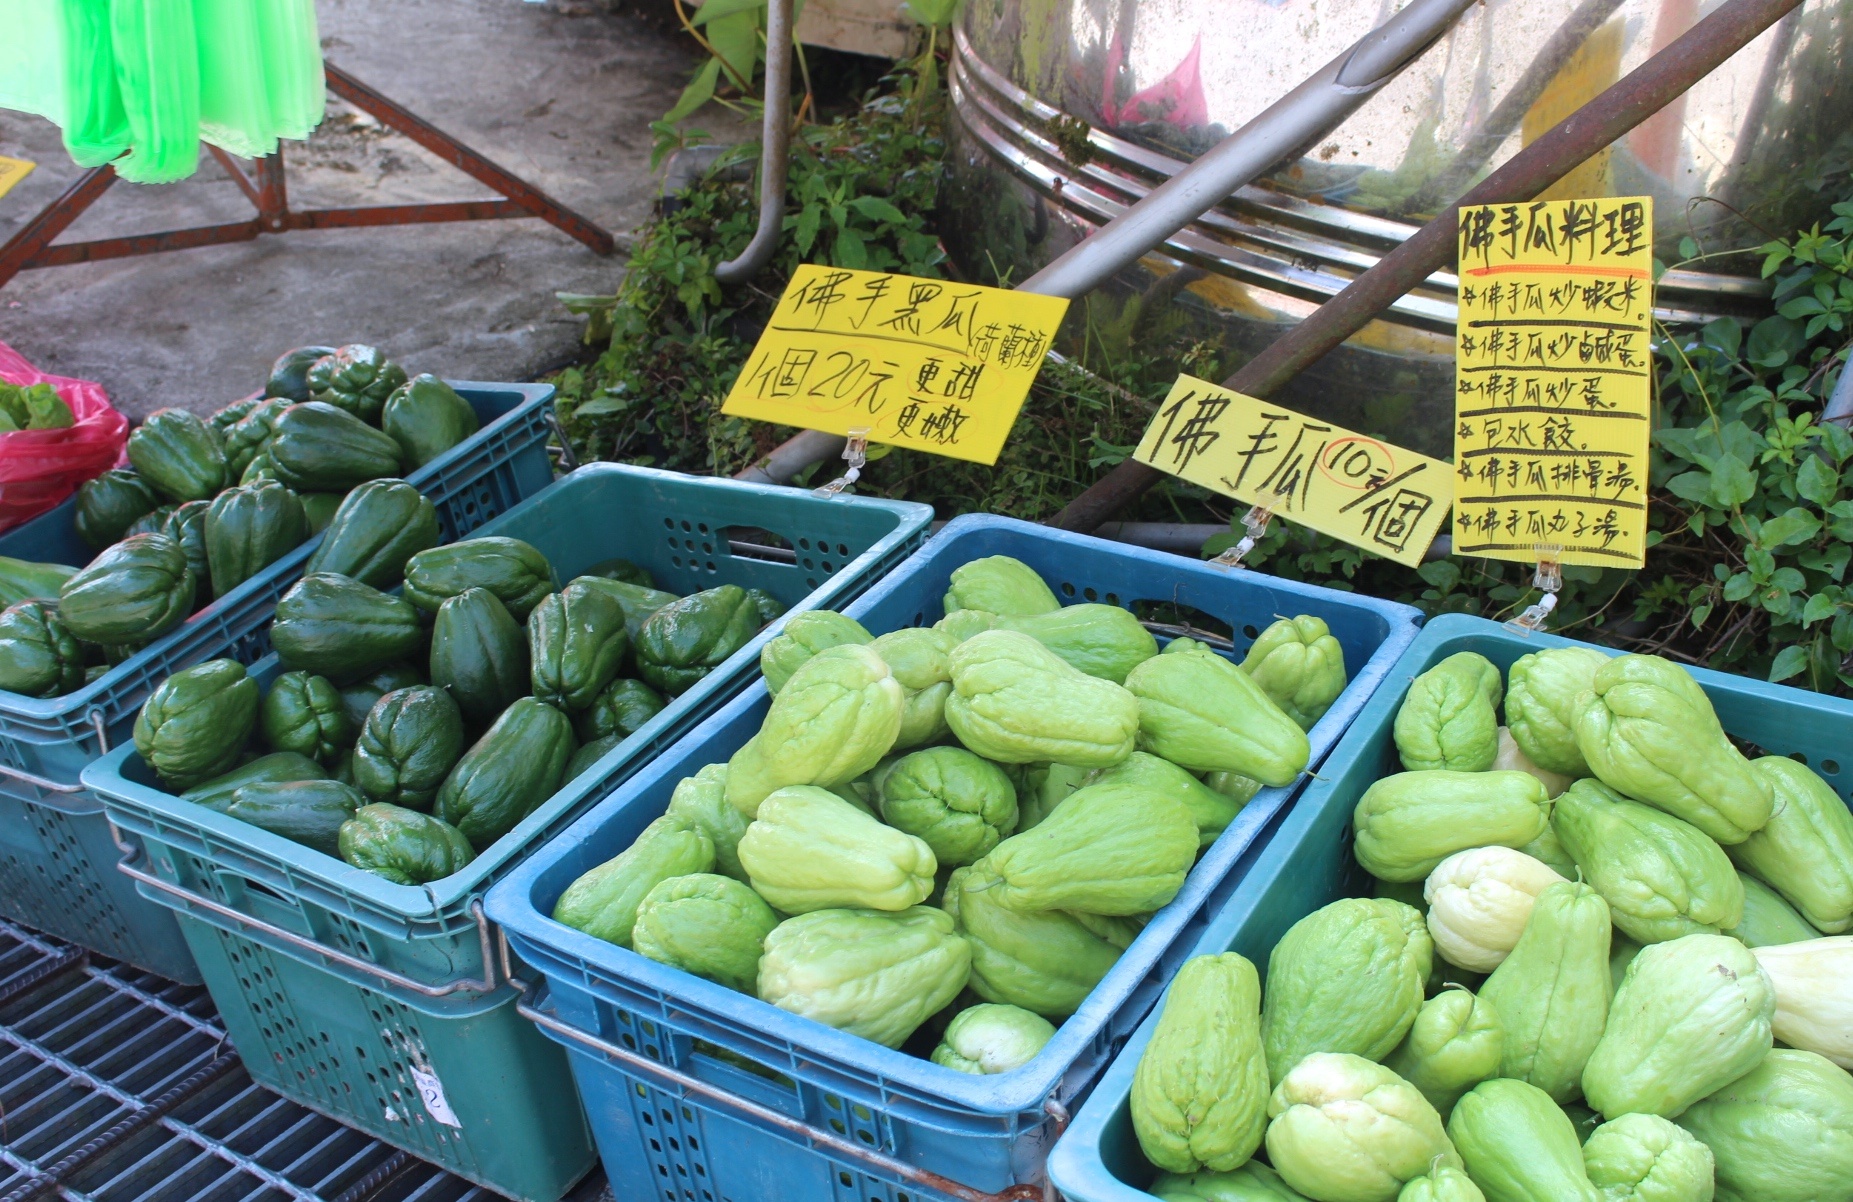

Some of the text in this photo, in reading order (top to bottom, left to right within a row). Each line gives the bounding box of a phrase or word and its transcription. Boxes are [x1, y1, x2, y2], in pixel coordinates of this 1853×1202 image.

[1459, 201, 1651, 270] 佛手瓜料理
[789, 271, 982, 348] 佛手黑瓜
[916, 357, 986, 403] 更甜
